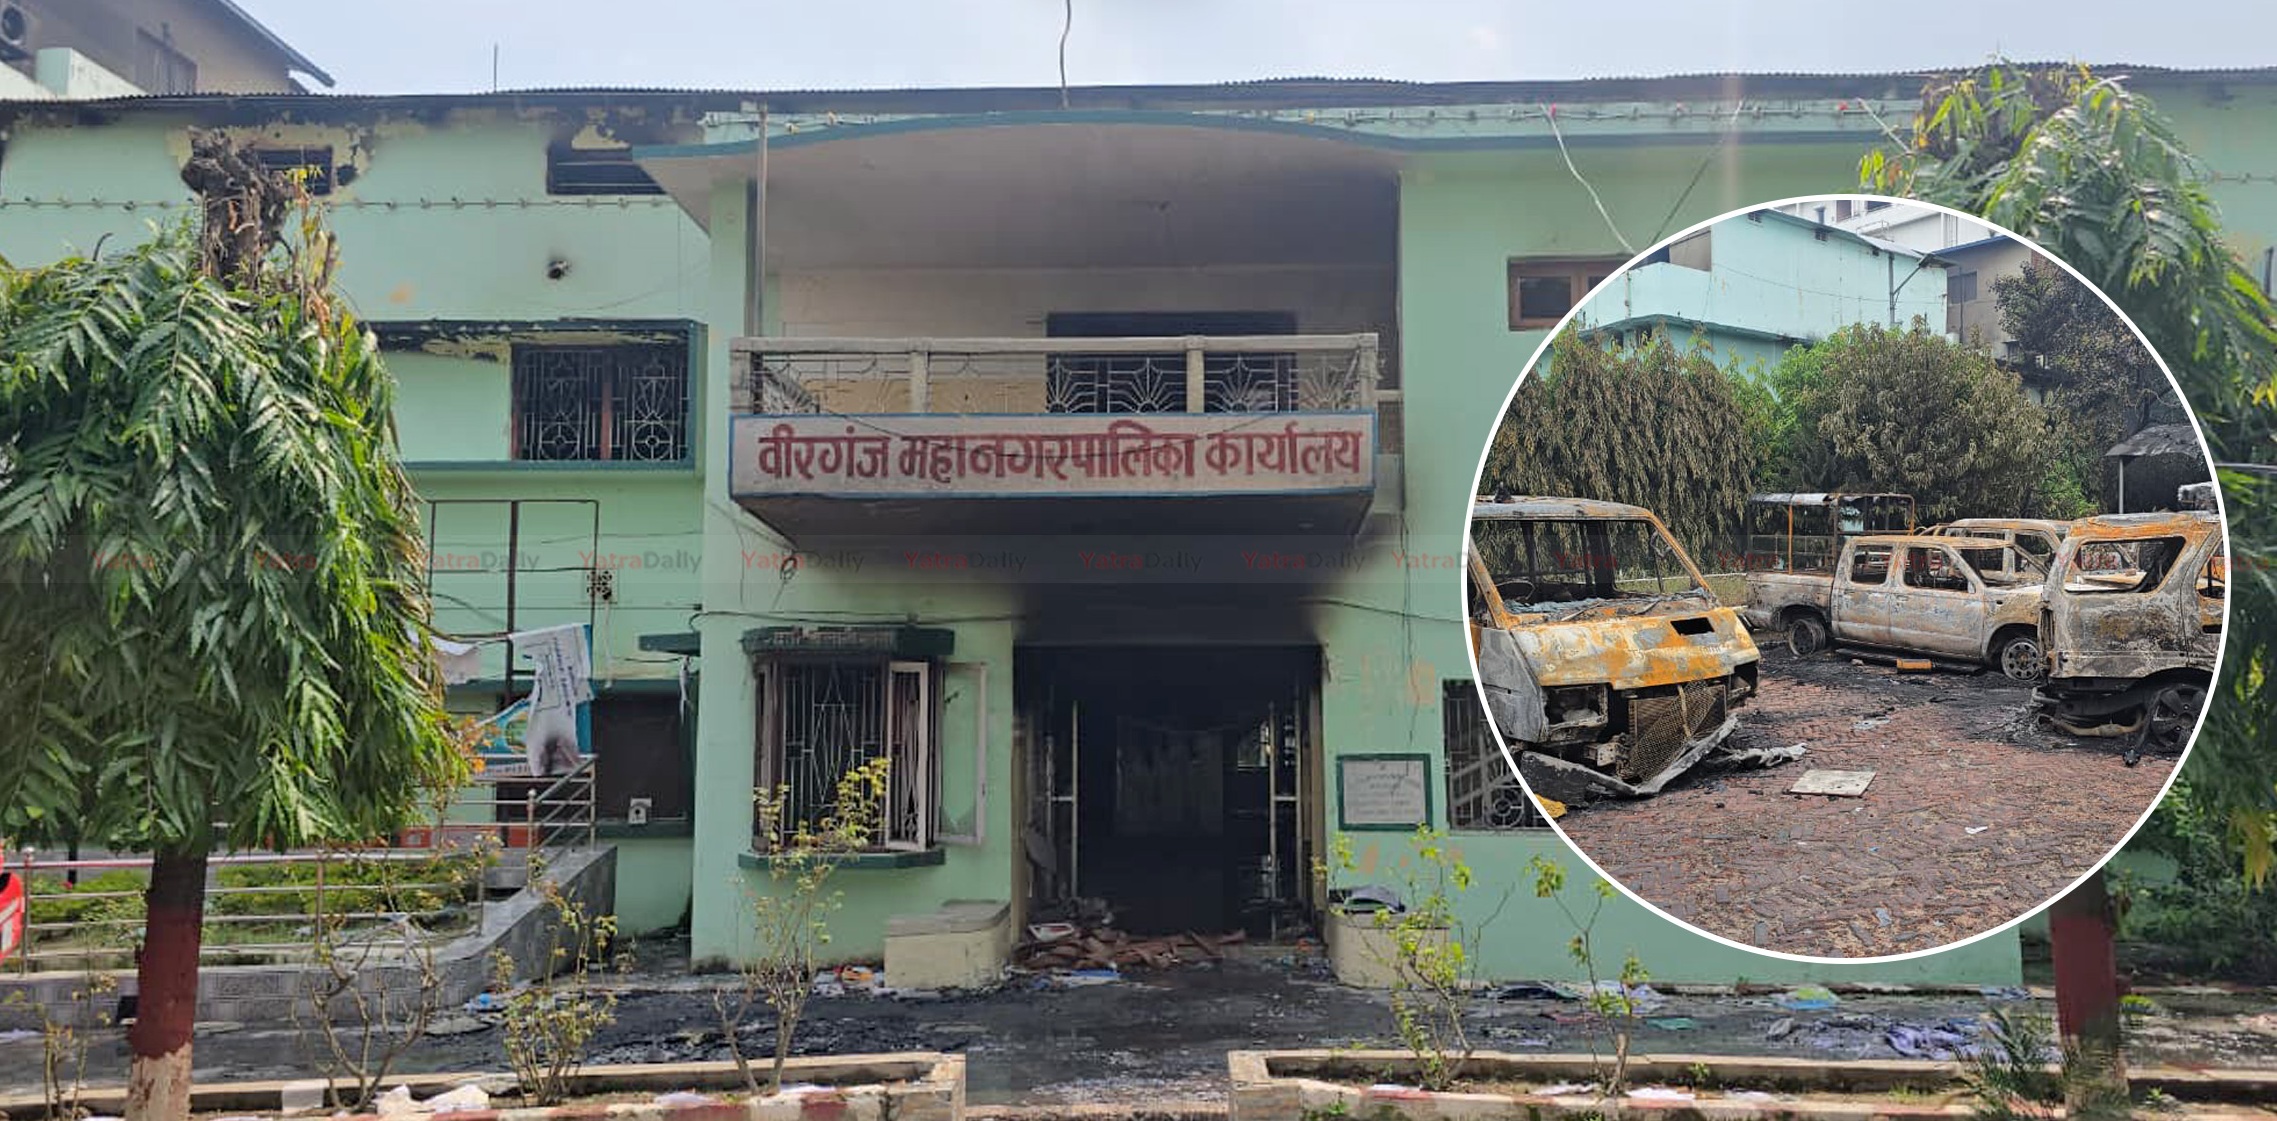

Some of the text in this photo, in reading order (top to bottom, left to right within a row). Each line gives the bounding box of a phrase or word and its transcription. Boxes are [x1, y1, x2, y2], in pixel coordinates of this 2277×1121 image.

[758, 419, 1363, 482] वीरगंज महानगरपालिका कार्यालय
